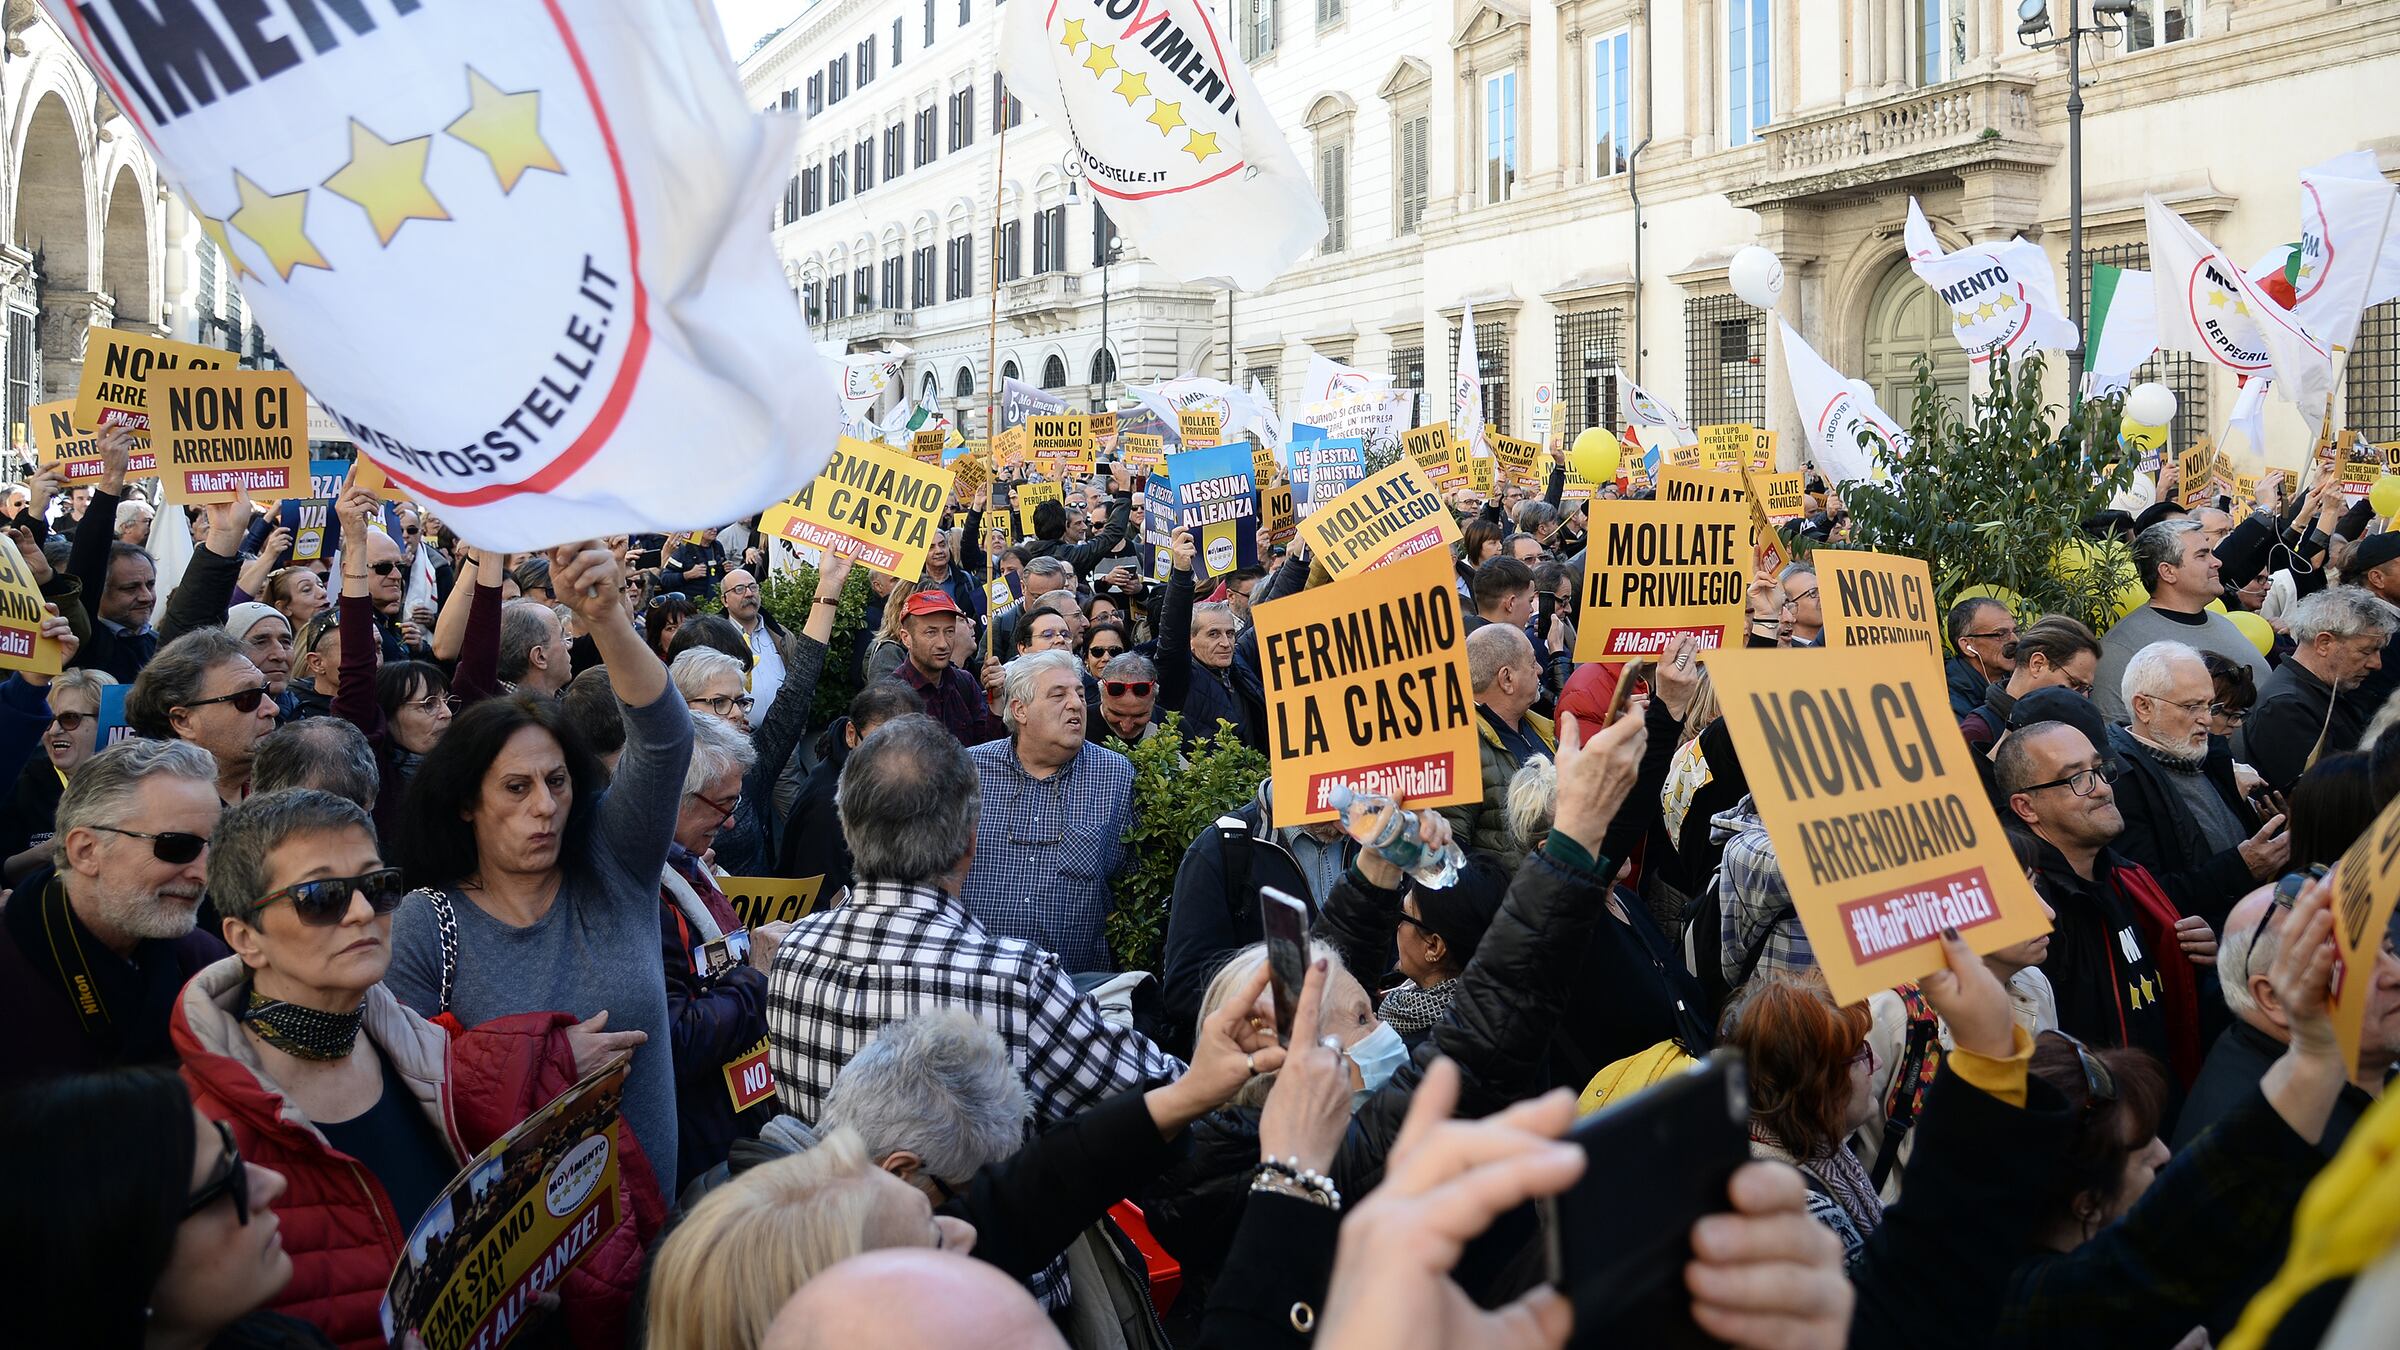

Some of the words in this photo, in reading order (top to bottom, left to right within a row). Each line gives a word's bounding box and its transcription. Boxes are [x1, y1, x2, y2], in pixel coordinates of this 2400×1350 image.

[1940, 266, 2009, 306] MENTO
[2205, 319, 2268, 361] BEPPEGRIL
[169, 386, 243, 431] NON
[255, 386, 288, 430] CI
[1361, 414, 1393, 424] IMPRESA
[1379, 403, 1387, 411] DI
[1034, 421, 1064, 437] NON
[1068, 421, 1082, 436] CI
[1091, 417, 1104, 429] NON
[1105, 416, 1112, 427] CI
[1182, 415, 1215, 427] MOLLATE
[1186, 427, 1220, 435] PRIVILEGIO
[1722, 426, 1739, 435] LUPO
[173, 436, 293, 464] ARRENDIAMO
[917, 433, 943, 444] MOLLATE
[1033, 439, 1082, 448] ARRENDIAMO
[1408, 435, 1430, 456] NON
[1433, 429, 1445, 449] CI
[1498, 440, 1521, 456] NON
[1523, 446, 1536, 458] CI
[1704, 436, 1725, 444] PERDE
[1727, 435, 1733, 443] IL
[1735, 433, 1749, 442] PELO
[1716, 443, 1726, 451] MA
[1757, 435, 1769, 449] CI
[1254, 453, 1269, 463] LATE
[1295, 446, 1310, 466] NÉ
[1315, 447, 1359, 463] DESTRA
[1456, 447, 1466, 463] CI
[1630, 458, 1643, 469] NO
[1674, 450, 1692, 461] NON
[1694, 447, 1700, 457] C
[1709, 451, 1716, 460] IL
[2186, 450, 2203, 478] NON
[820, 451, 942, 513] RMIAMO
[1293, 463, 1309, 484] NÉ
[1314, 464, 1364, 482] SINISTRA
[2239, 478, 2254, 488] MOLL
[311, 475, 343, 499] RZA
[1039, 486, 1052, 495] LUPO
[1179, 474, 1249, 504] NESSUNA
[1316, 483, 1347, 499] SOLO
[782, 481, 816, 511] A
[828, 489, 927, 549] CASTA
[1183, 497, 1253, 529] ALLEANZA
[1271, 493, 1291, 517] NO
[1316, 471, 1421, 548] MOLLATE
[299, 506, 327, 529] VIA
[1325, 552, 1349, 574] IL
[1344, 492, 1441, 560] PRIVILEGIO
[1607, 523, 1735, 567] MOLLATE
[1589, 572, 1612, 607] IL
[1621, 570, 1742, 607] PRIVILEGIO
[1836, 569, 1900, 618] NON
[1902, 574, 1927, 622] CI
[1266, 585, 1455, 691] FERMIAMO
[1276, 696, 1330, 760] LA
[1344, 661, 1469, 747] CASTA
[1750, 687, 1882, 802] NON
[1870, 681, 1945, 783] CI
[1798, 794, 1978, 886] ARRENDIAMO
[730, 894, 774, 928] ON
[1851, 877, 1992, 958] #MaiPiùVitalizi
[74, 974, 99, 1015] Nikon
[743, 1062, 768, 1096] NO
[549, 1141, 606, 1195] MOVIMENTO
[464, 1200, 535, 1292] SIAMO
